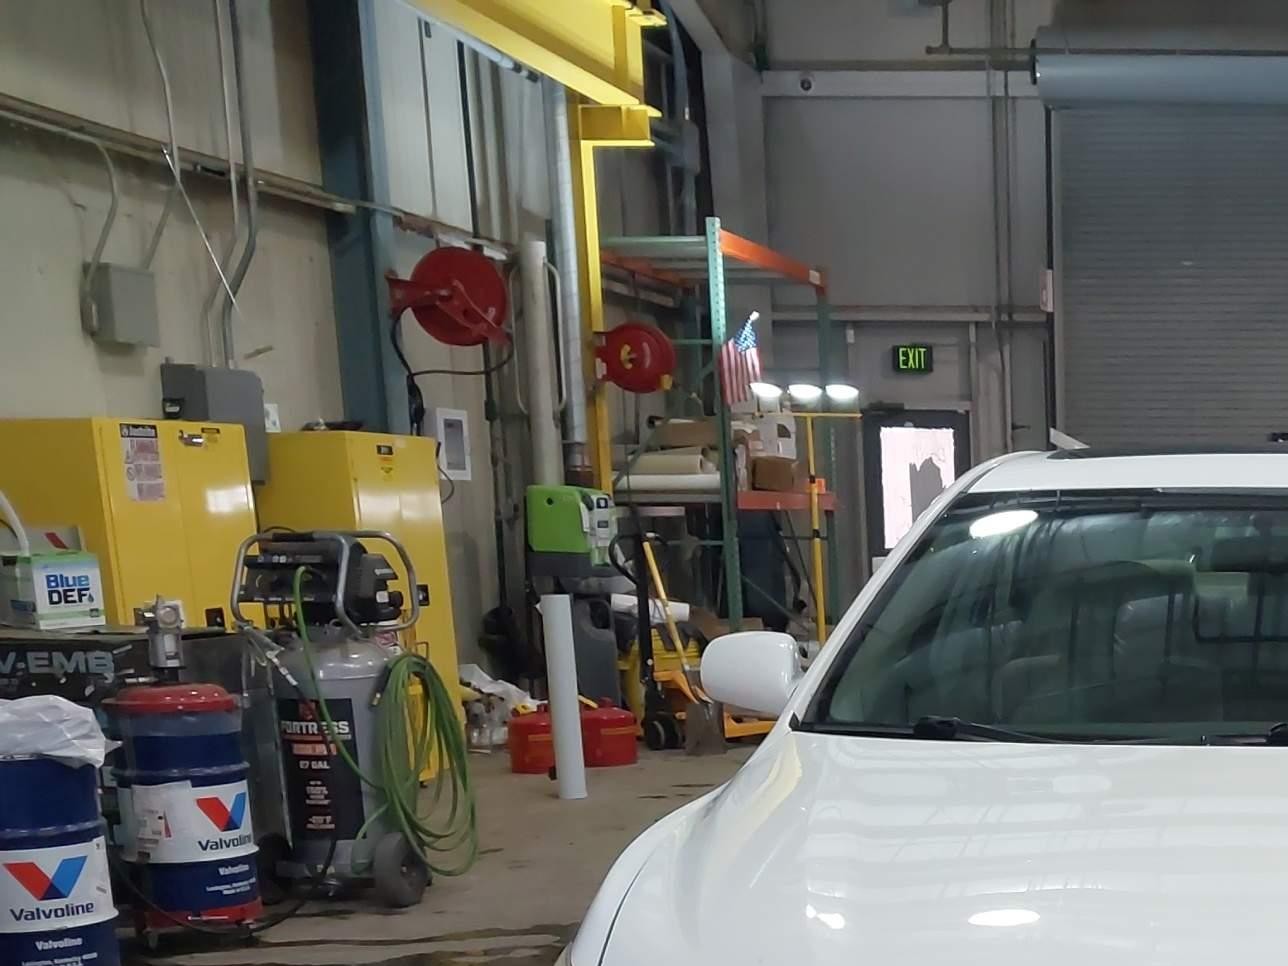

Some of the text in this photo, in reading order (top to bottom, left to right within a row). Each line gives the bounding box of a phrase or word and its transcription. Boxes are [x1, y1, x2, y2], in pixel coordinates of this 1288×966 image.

[899, 347, 928, 369] EXIT
[45, 573, 90, 589] Blue
[48, 587, 91, 605] DEF
[9, 901, 95, 922] Valvoline
